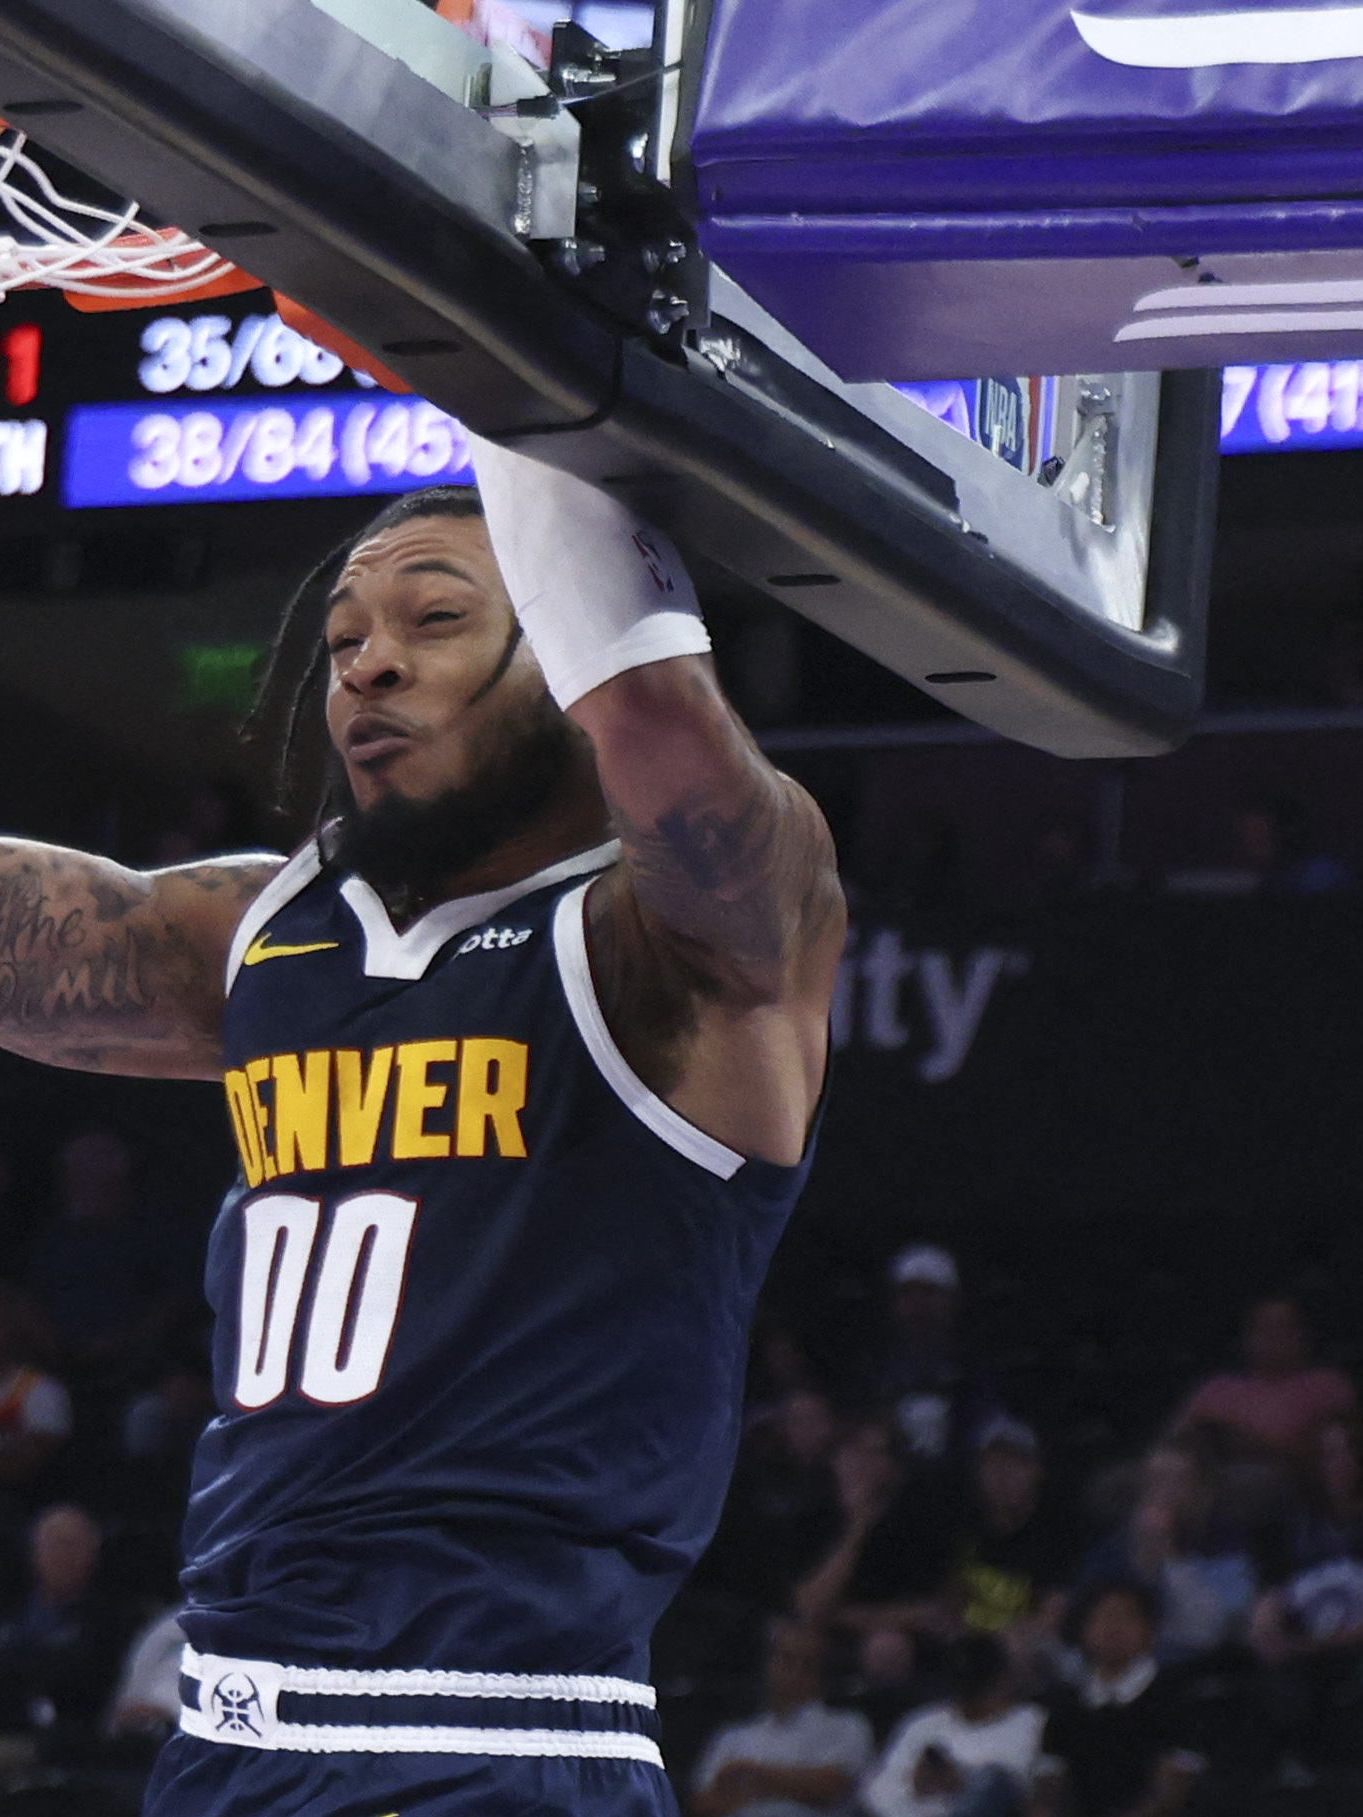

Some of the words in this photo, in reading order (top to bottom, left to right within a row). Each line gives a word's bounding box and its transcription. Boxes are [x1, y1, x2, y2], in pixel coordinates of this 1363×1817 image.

[128, 407, 336, 490] 38/84
[223, 1034, 531, 1190] DENVER
[232, 1187, 423, 1414] 00
